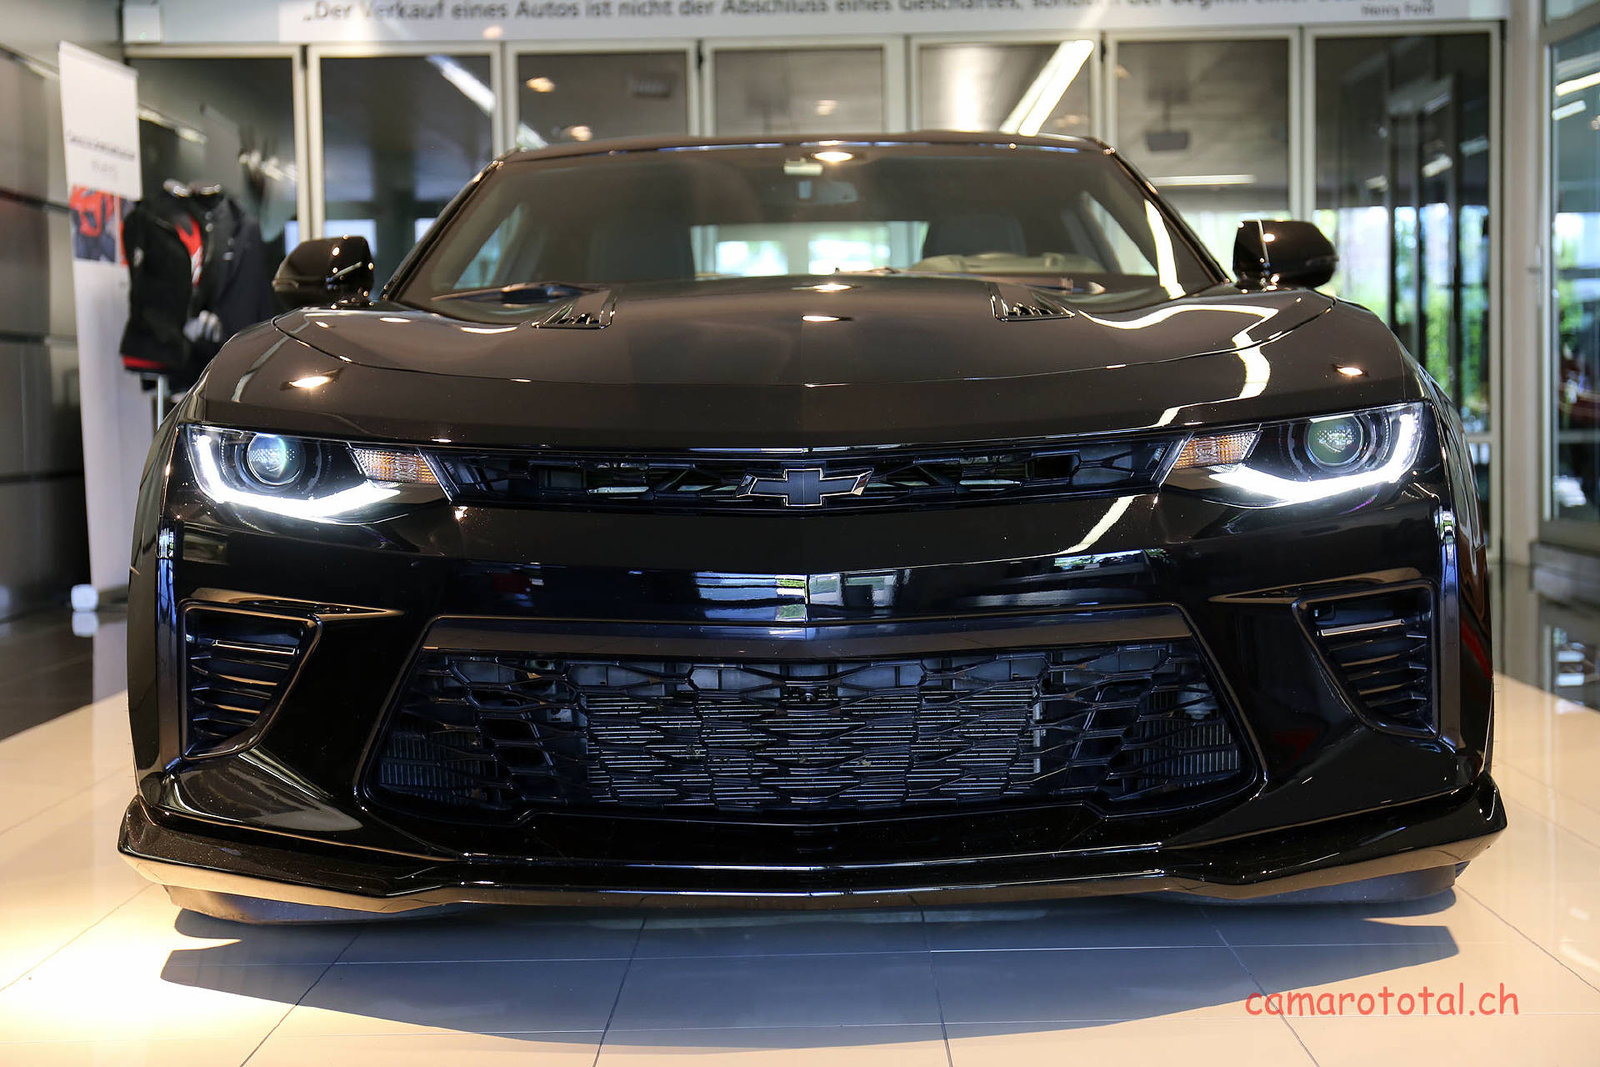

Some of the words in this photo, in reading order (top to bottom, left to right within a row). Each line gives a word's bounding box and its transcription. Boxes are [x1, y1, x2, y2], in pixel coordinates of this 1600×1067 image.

[451, 2, 509, 18] eines
[515, 0, 580, 17] Autos
[584, 0, 612, 16] ist
[618, 0, 674, 16] nicht
[679, 0, 714, 15] der
